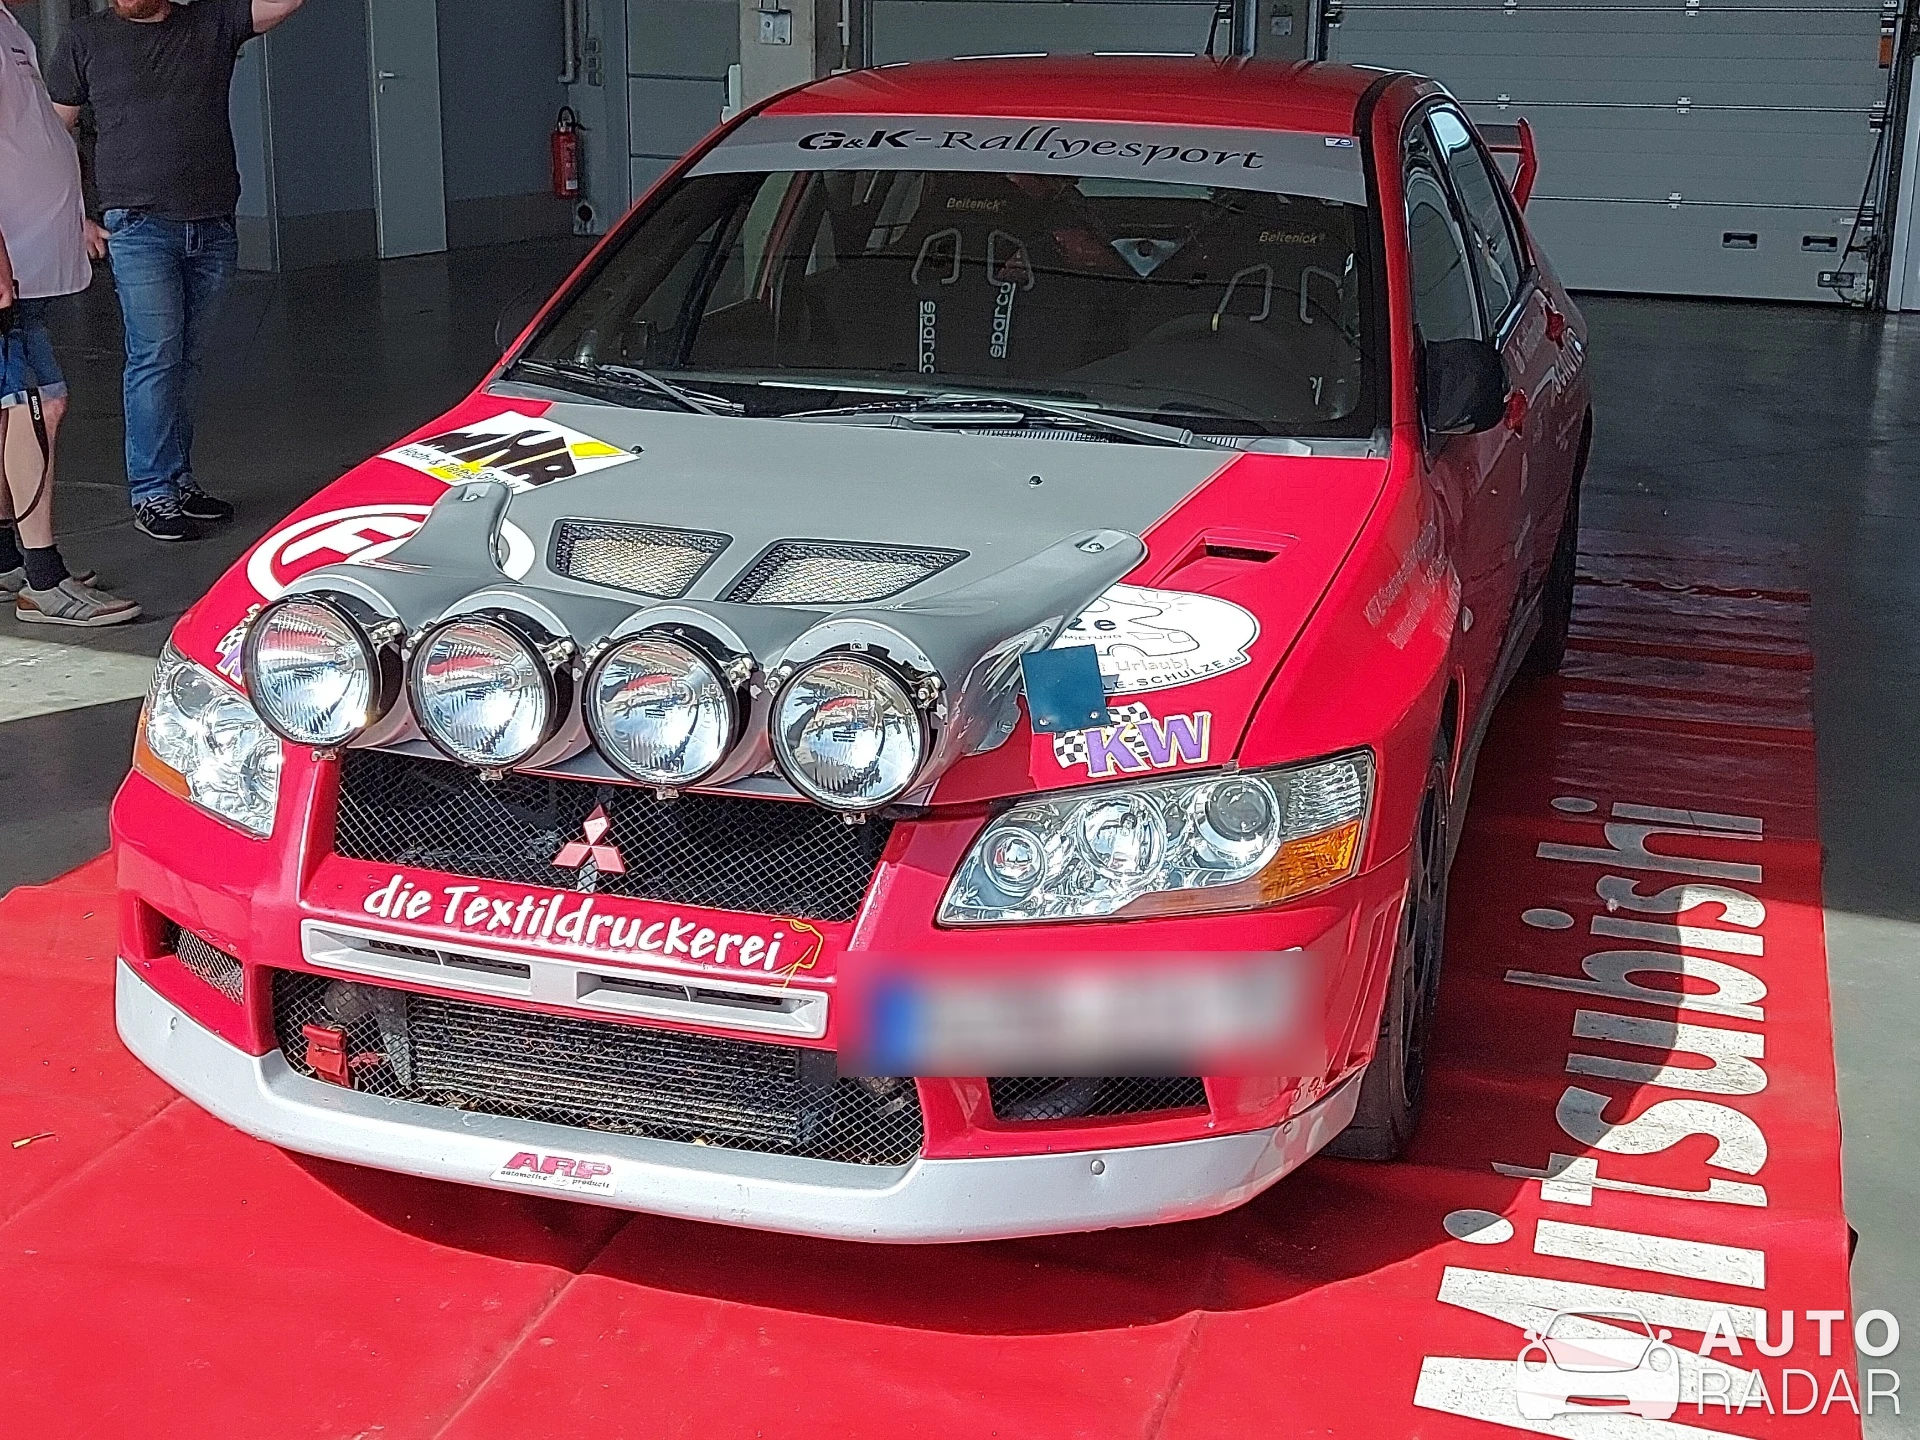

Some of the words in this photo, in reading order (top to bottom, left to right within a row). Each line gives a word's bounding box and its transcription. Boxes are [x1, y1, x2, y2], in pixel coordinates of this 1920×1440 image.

[797, 125, 1266, 171] G&K-Rallyesport
[922, 301, 936, 374] sparco
[990, 282, 1011, 358] sparco
[1060, 633, 1122, 641] MIETUNG
[1066, 617, 1117, 631] ze
[1103, 655, 1242, 691] LE-SCHULZE.de
[1085, 712, 1212, 777] KW
[364, 874, 432, 921] die
[443, 885, 786, 972] Textildruckerei
[1414, 797, 1768, 1440] Mitsubishi
[502, 1151, 612, 1180] ARP
